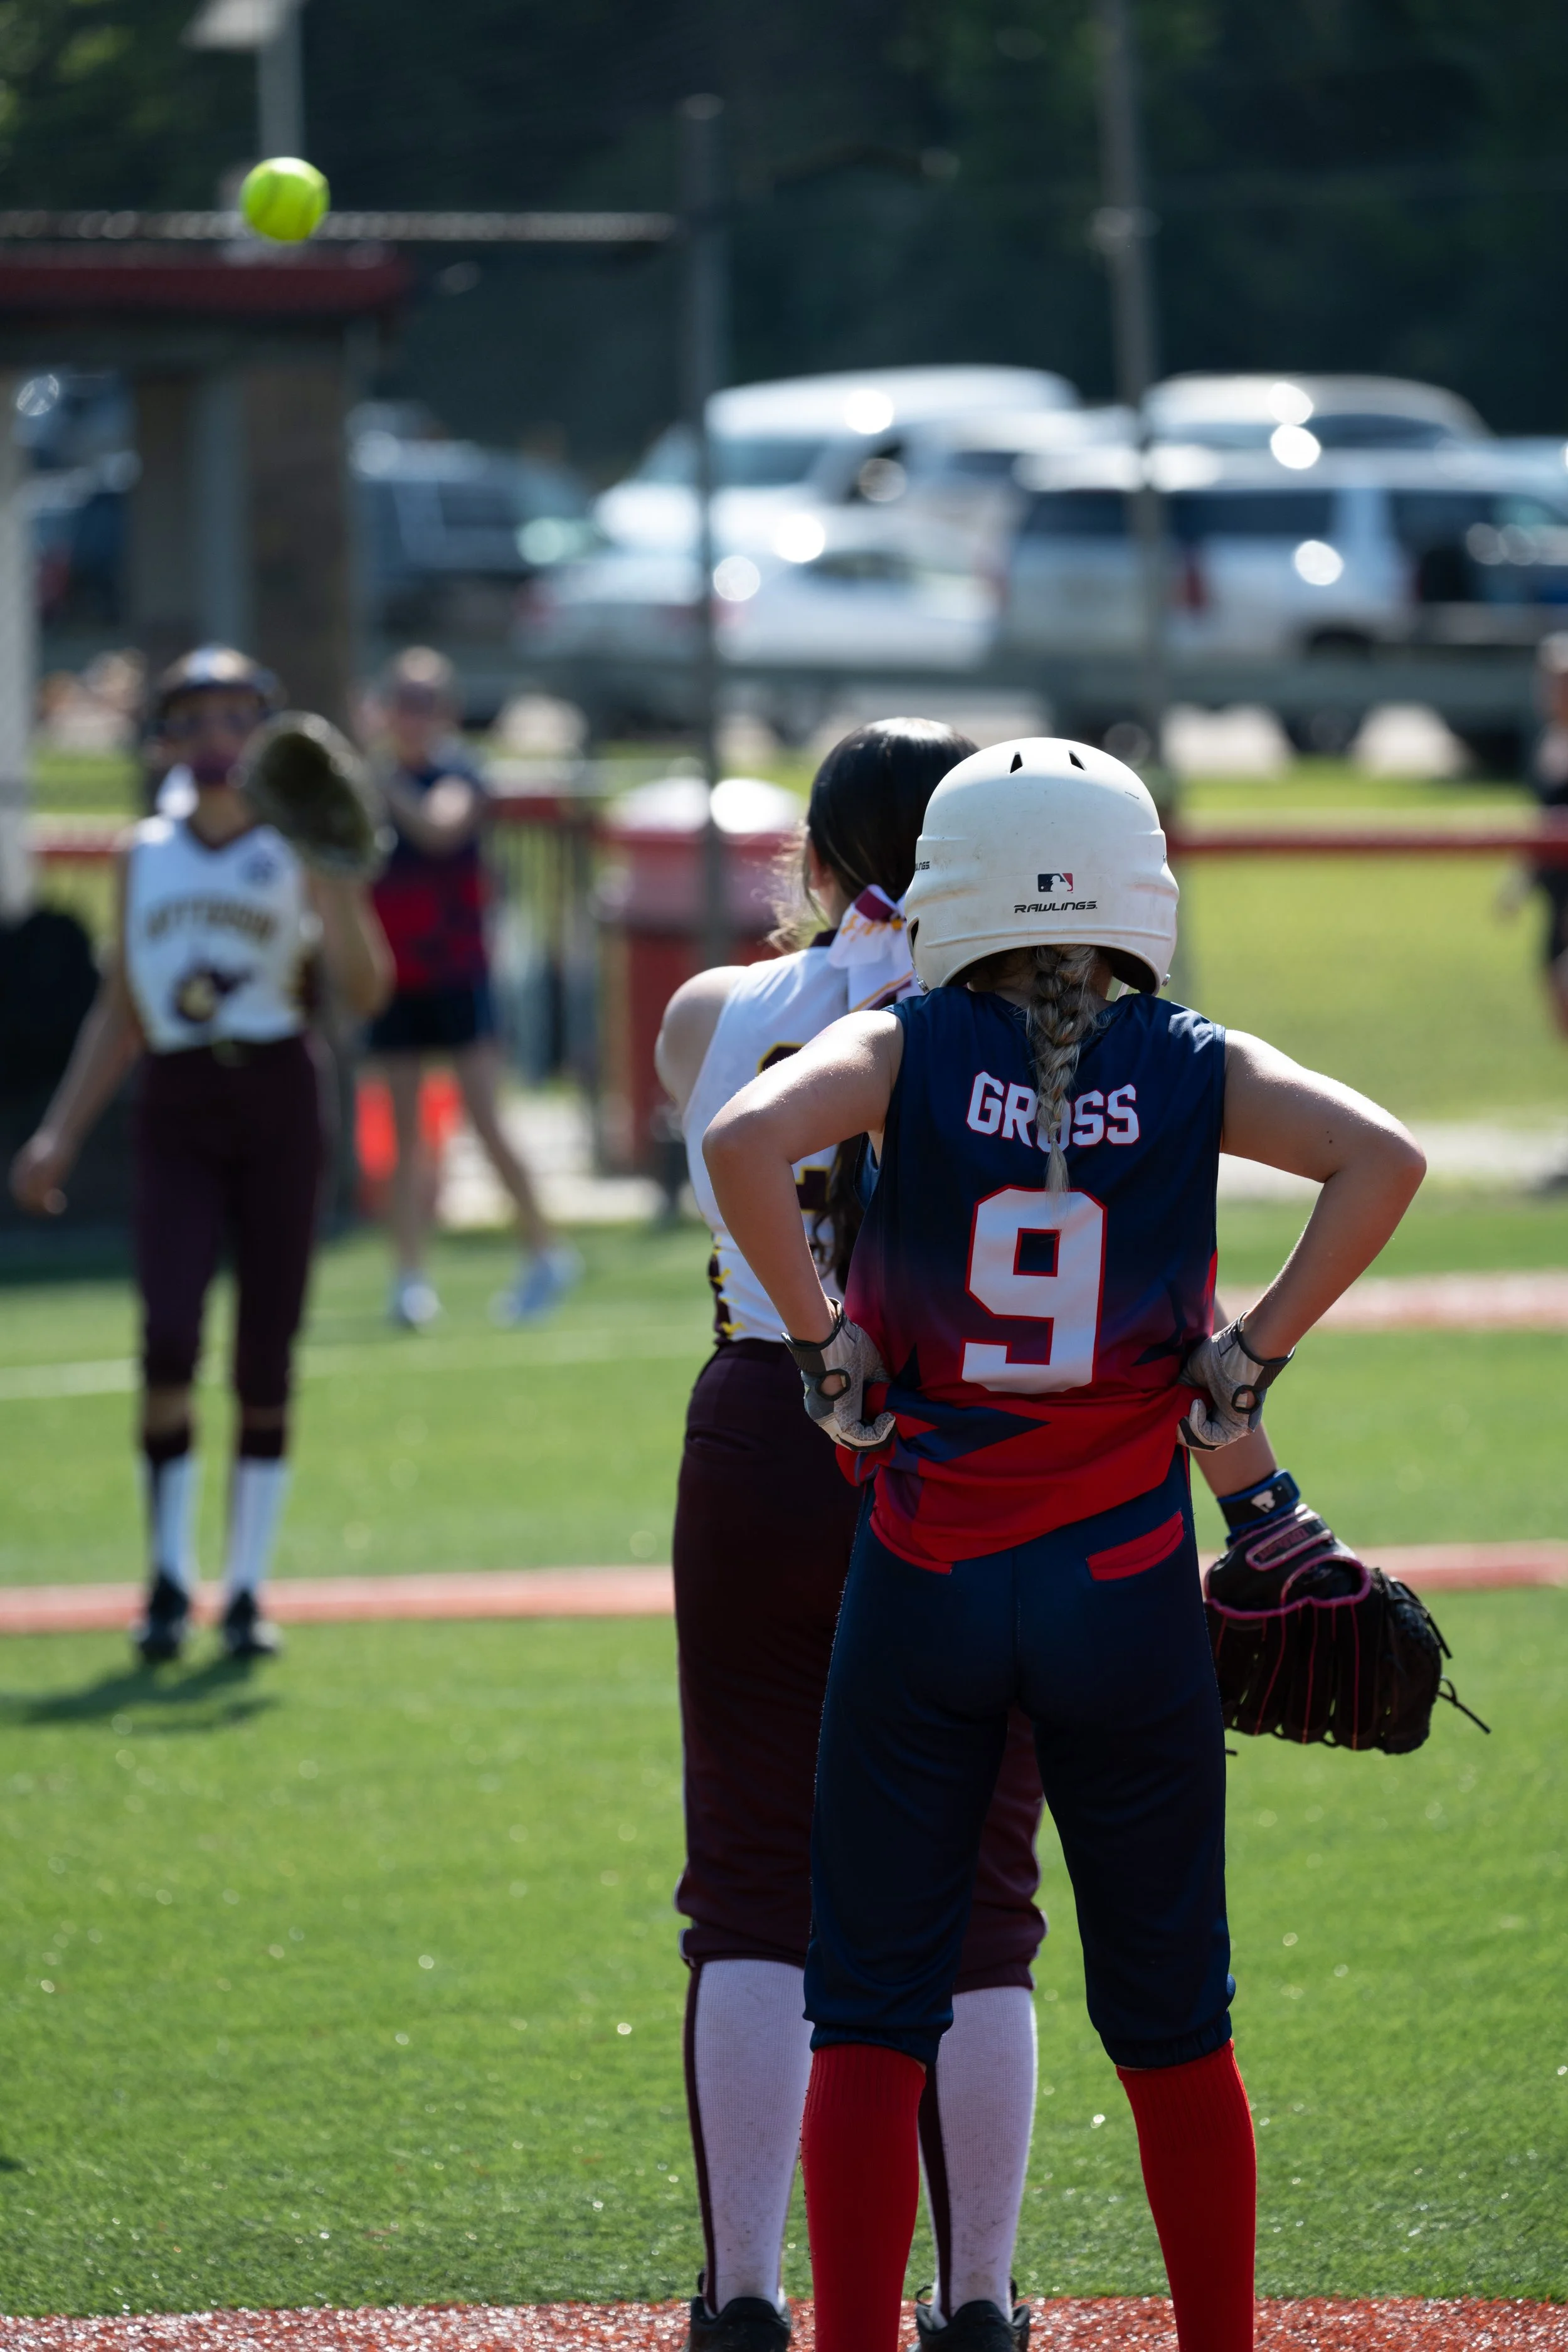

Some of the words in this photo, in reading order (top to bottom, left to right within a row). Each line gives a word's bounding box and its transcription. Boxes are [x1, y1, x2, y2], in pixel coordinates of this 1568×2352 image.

[1014, 901, 1098, 913] RAWLINGS
[966, 1071, 1140, 1153] GROSS
[960, 1184, 1108, 1394] 9
